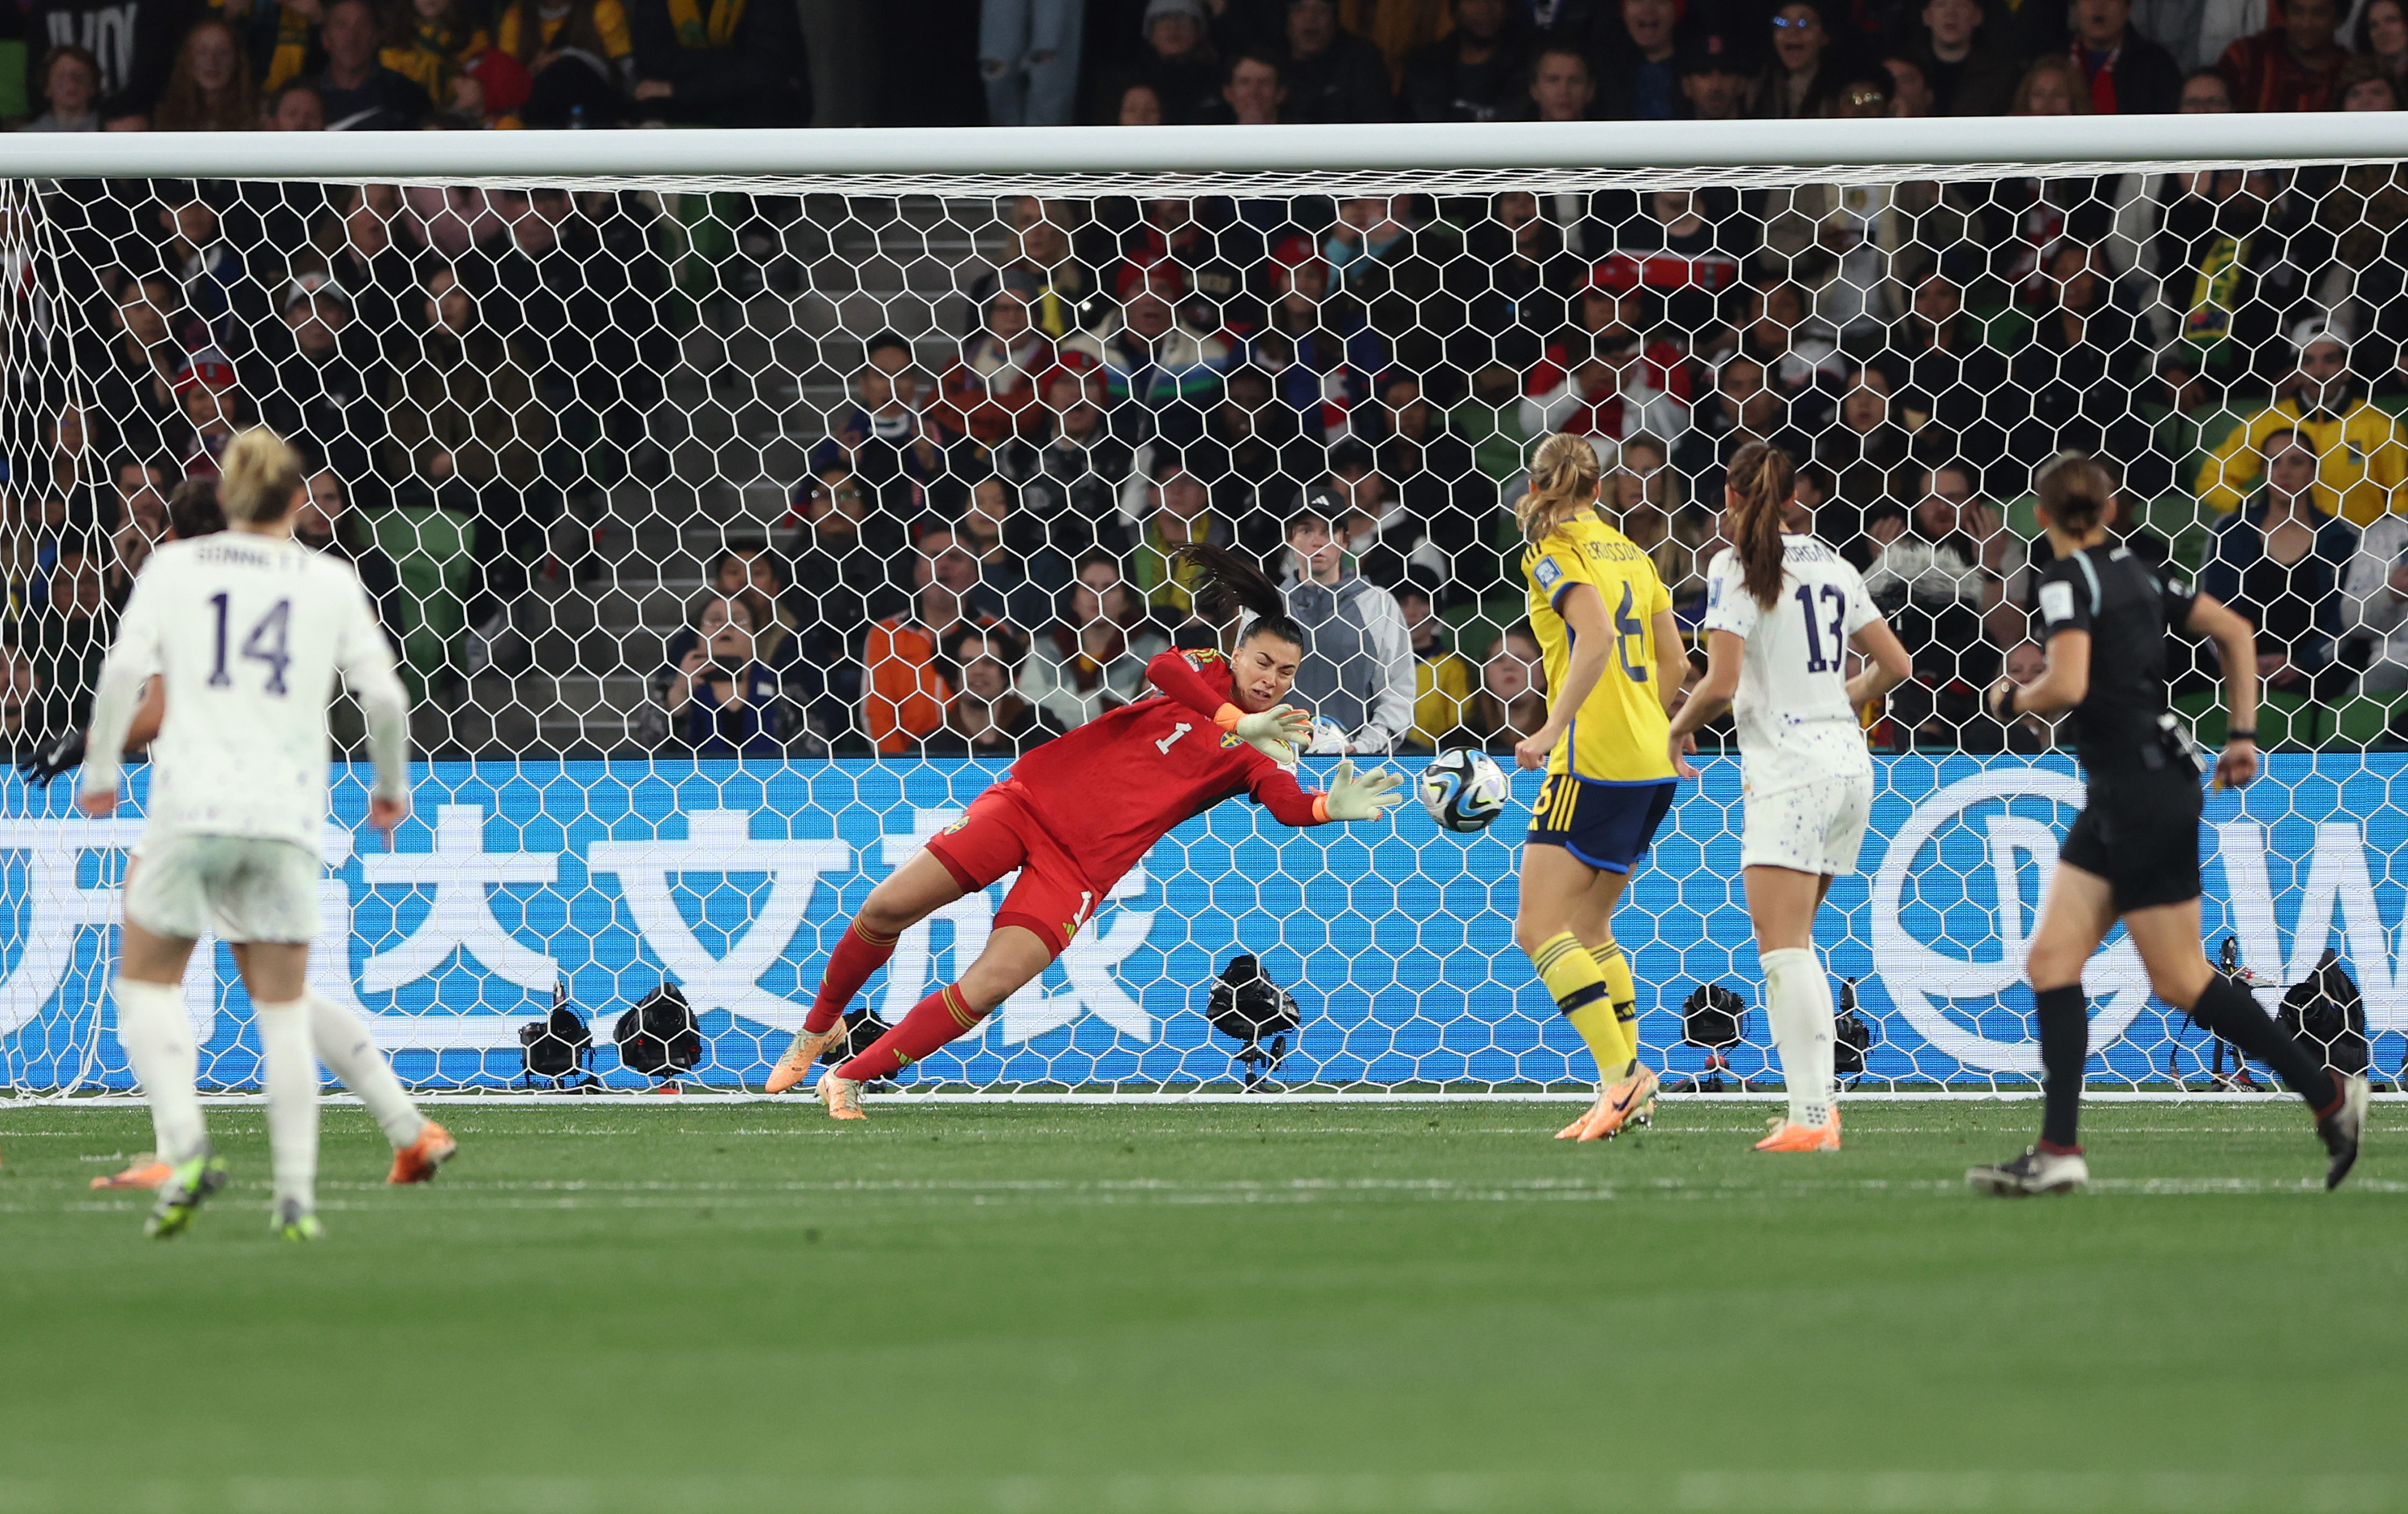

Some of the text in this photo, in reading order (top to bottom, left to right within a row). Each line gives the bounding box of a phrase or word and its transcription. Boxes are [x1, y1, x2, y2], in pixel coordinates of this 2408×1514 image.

[209, 592, 291, 695] 14
[1614, 580, 1648, 682] 6
[1795, 583, 1846, 674] 13
[1154, 722, 1193, 755] 1
